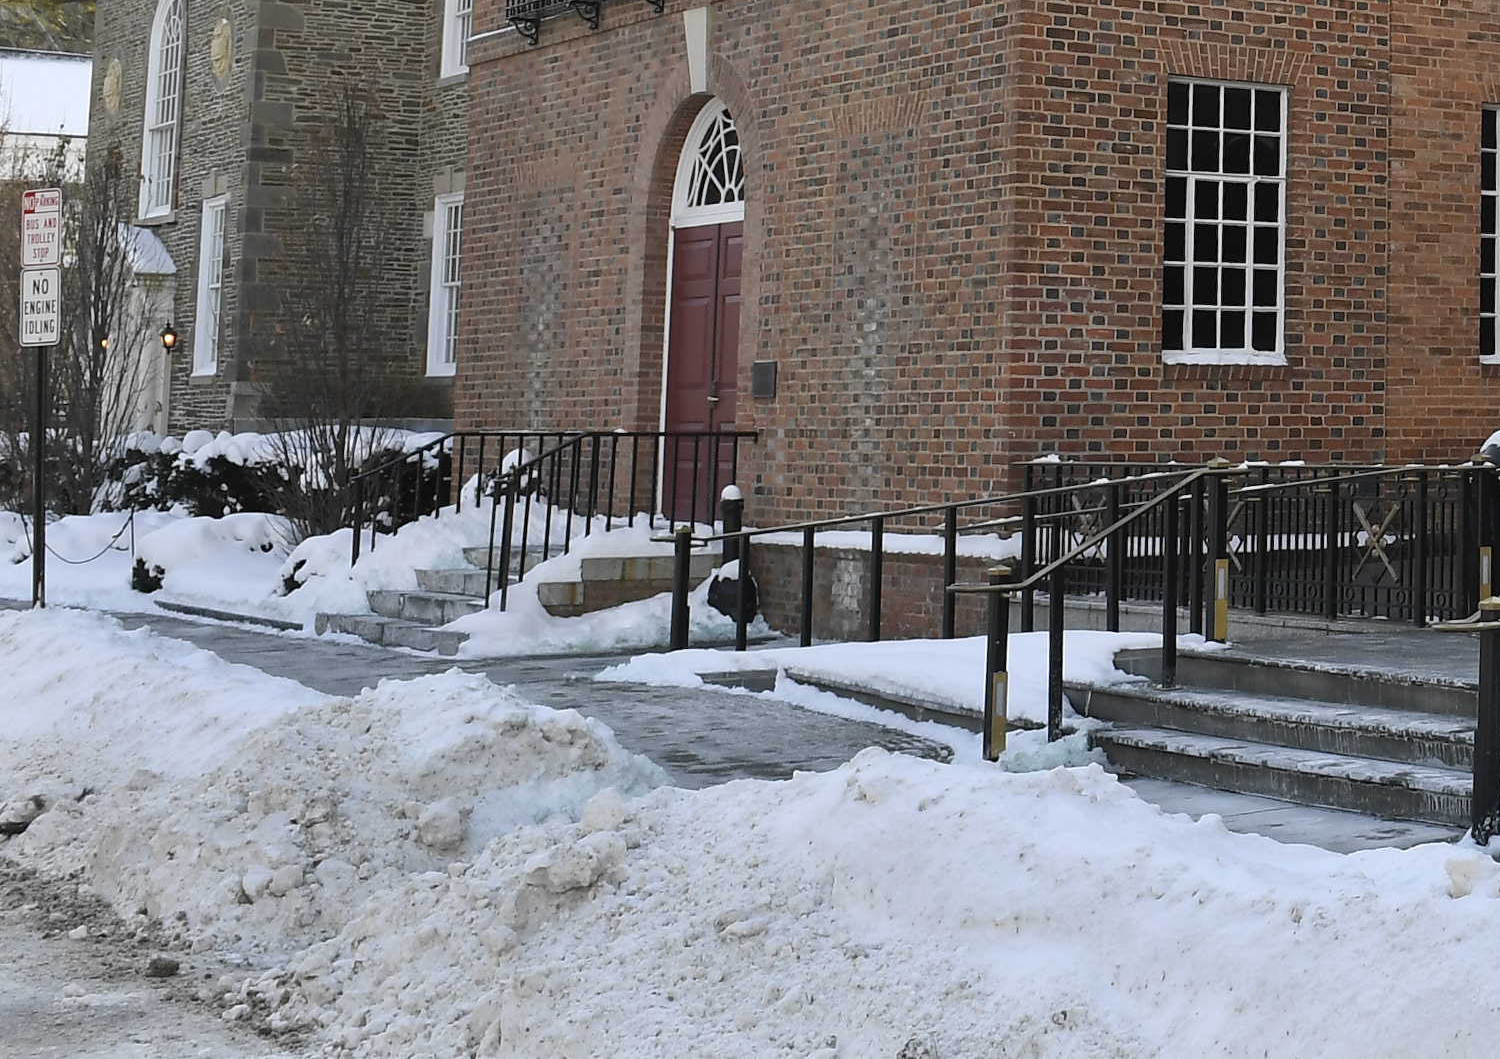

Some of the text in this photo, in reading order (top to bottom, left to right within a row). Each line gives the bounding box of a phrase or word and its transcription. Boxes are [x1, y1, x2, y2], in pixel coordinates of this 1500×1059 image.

[24, 195, 60, 211] NO PARKING
[26, 217, 57, 231] BUS AND
[27, 232, 55, 245] TROLLEY
[32, 247, 50, 259] STOP
[32, 278, 49, 295] NO
[24, 299, 56, 316] ENGINE
[25, 319, 55, 335] IDLING
